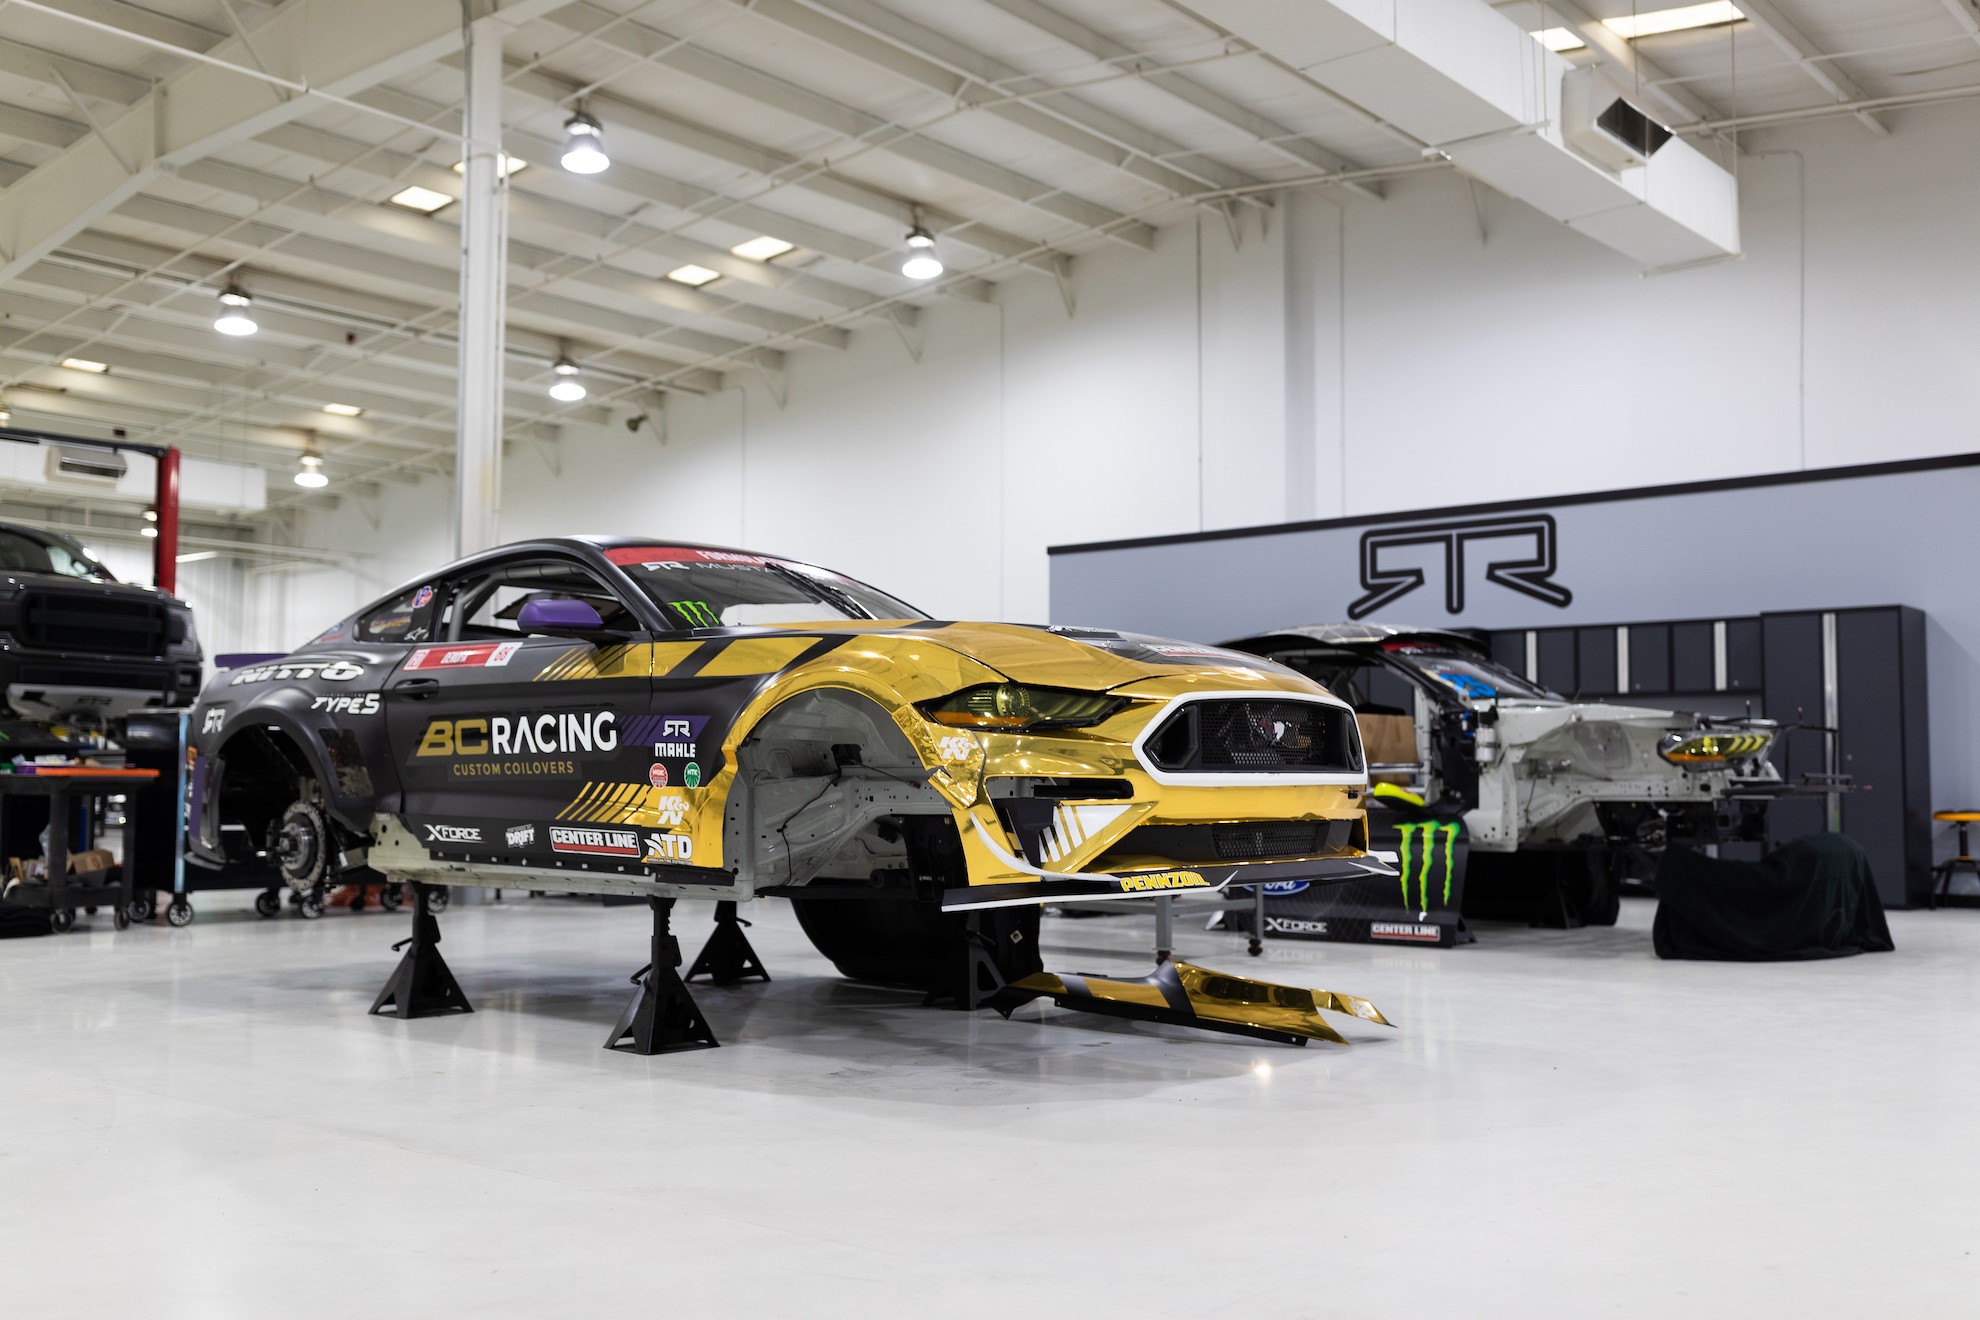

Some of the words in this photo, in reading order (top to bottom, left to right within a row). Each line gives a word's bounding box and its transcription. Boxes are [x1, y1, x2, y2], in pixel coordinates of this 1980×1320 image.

[1347, 514, 1573, 620] RTR
[230, 661, 364, 686] NITTO
[202, 708, 226, 734] RTR
[662, 720, 691, 738] RTR
[416, 719, 488, 757] BC
[491, 711, 618, 755] RACING
[654, 742, 696, 758] MAHLE
[940, 736, 978, 760] K&N
[453, 762, 501, 776] CUSTOM
[504, 760, 574, 775] COILOVERS
[687, 768, 698, 776] NTK
[657, 795, 690, 825] K&N
[424, 824, 484, 843] XFORCE
[505, 827, 535, 847] DRIFT
[553, 829, 604, 846] CENTER
[606, 833, 637, 848] LINE
[643, 833, 693, 860] ATD
[1120, 871, 1211, 892] PENNZOIL
[1264, 917, 1328, 934] XFORCE
[1371, 922, 1413, 934] CENTER
[1414, 924, 1439, 937] LINE
